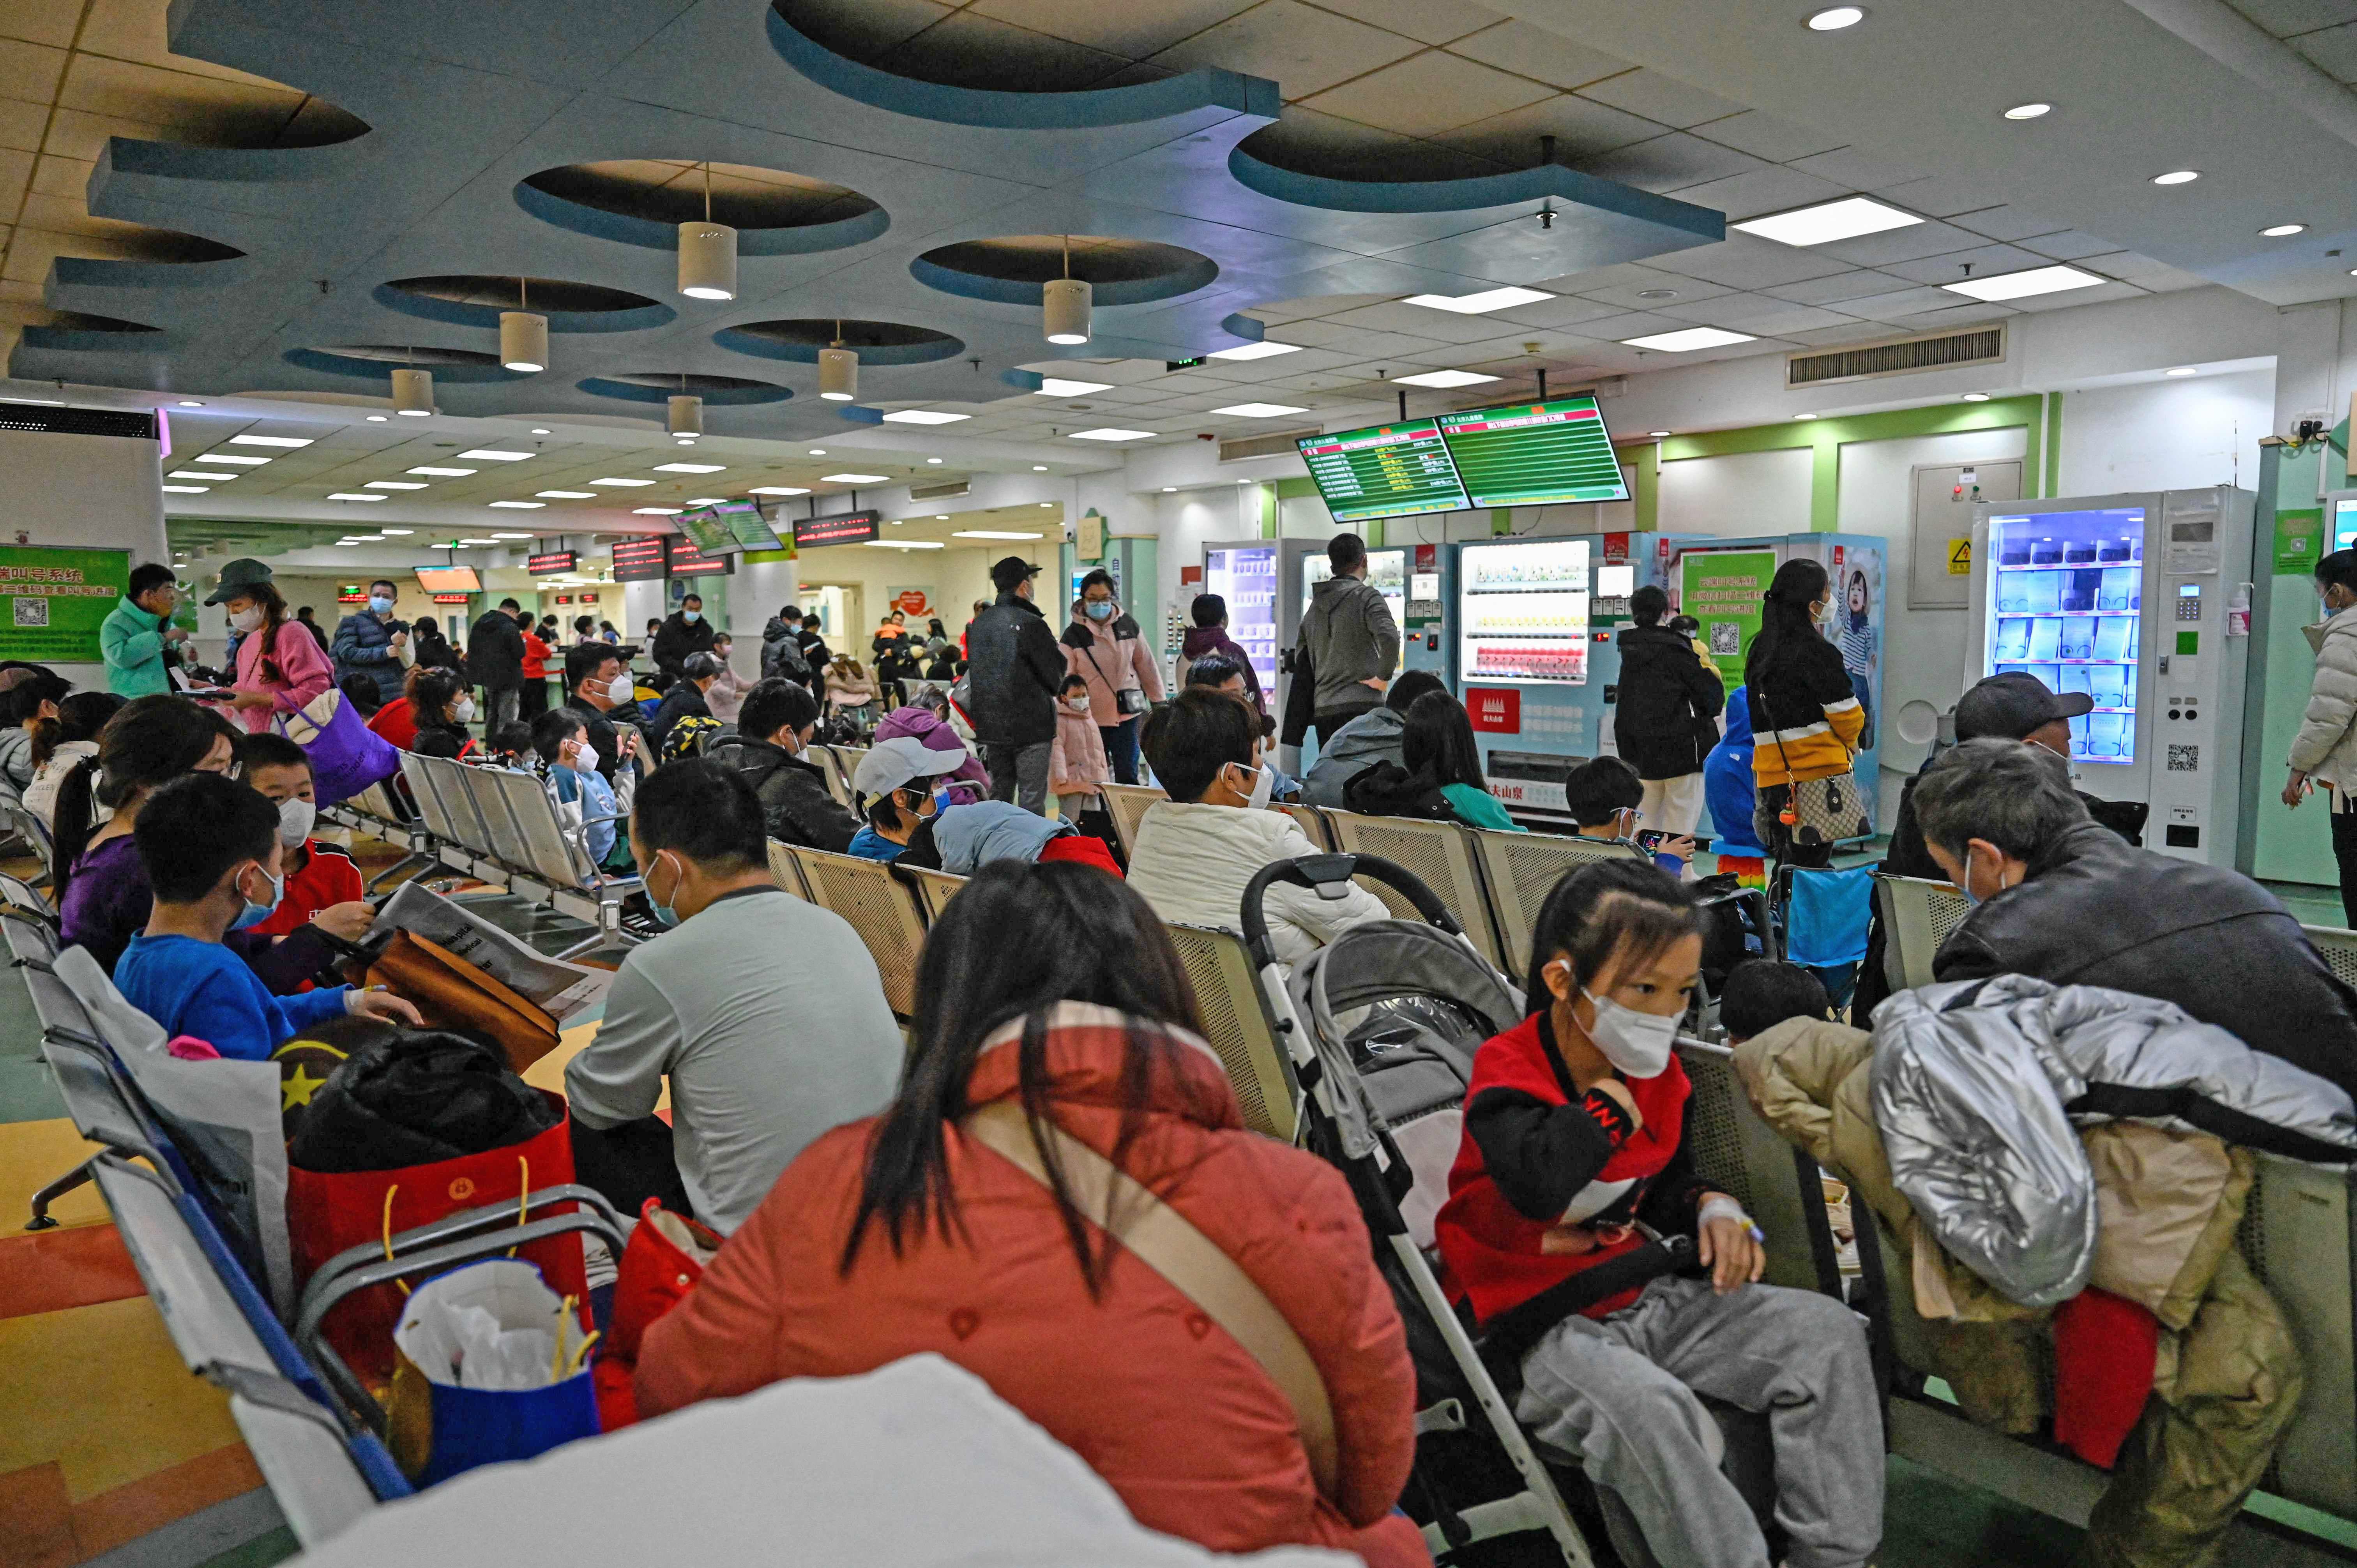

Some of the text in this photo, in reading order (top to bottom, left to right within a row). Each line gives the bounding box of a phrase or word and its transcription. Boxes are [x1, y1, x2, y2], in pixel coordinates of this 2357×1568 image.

[0, 584, 117, 597] 二维码查看叫号进度
[1486, 783, 1523, 800] 夫山泉
[479, 959, 493, 971] ter
